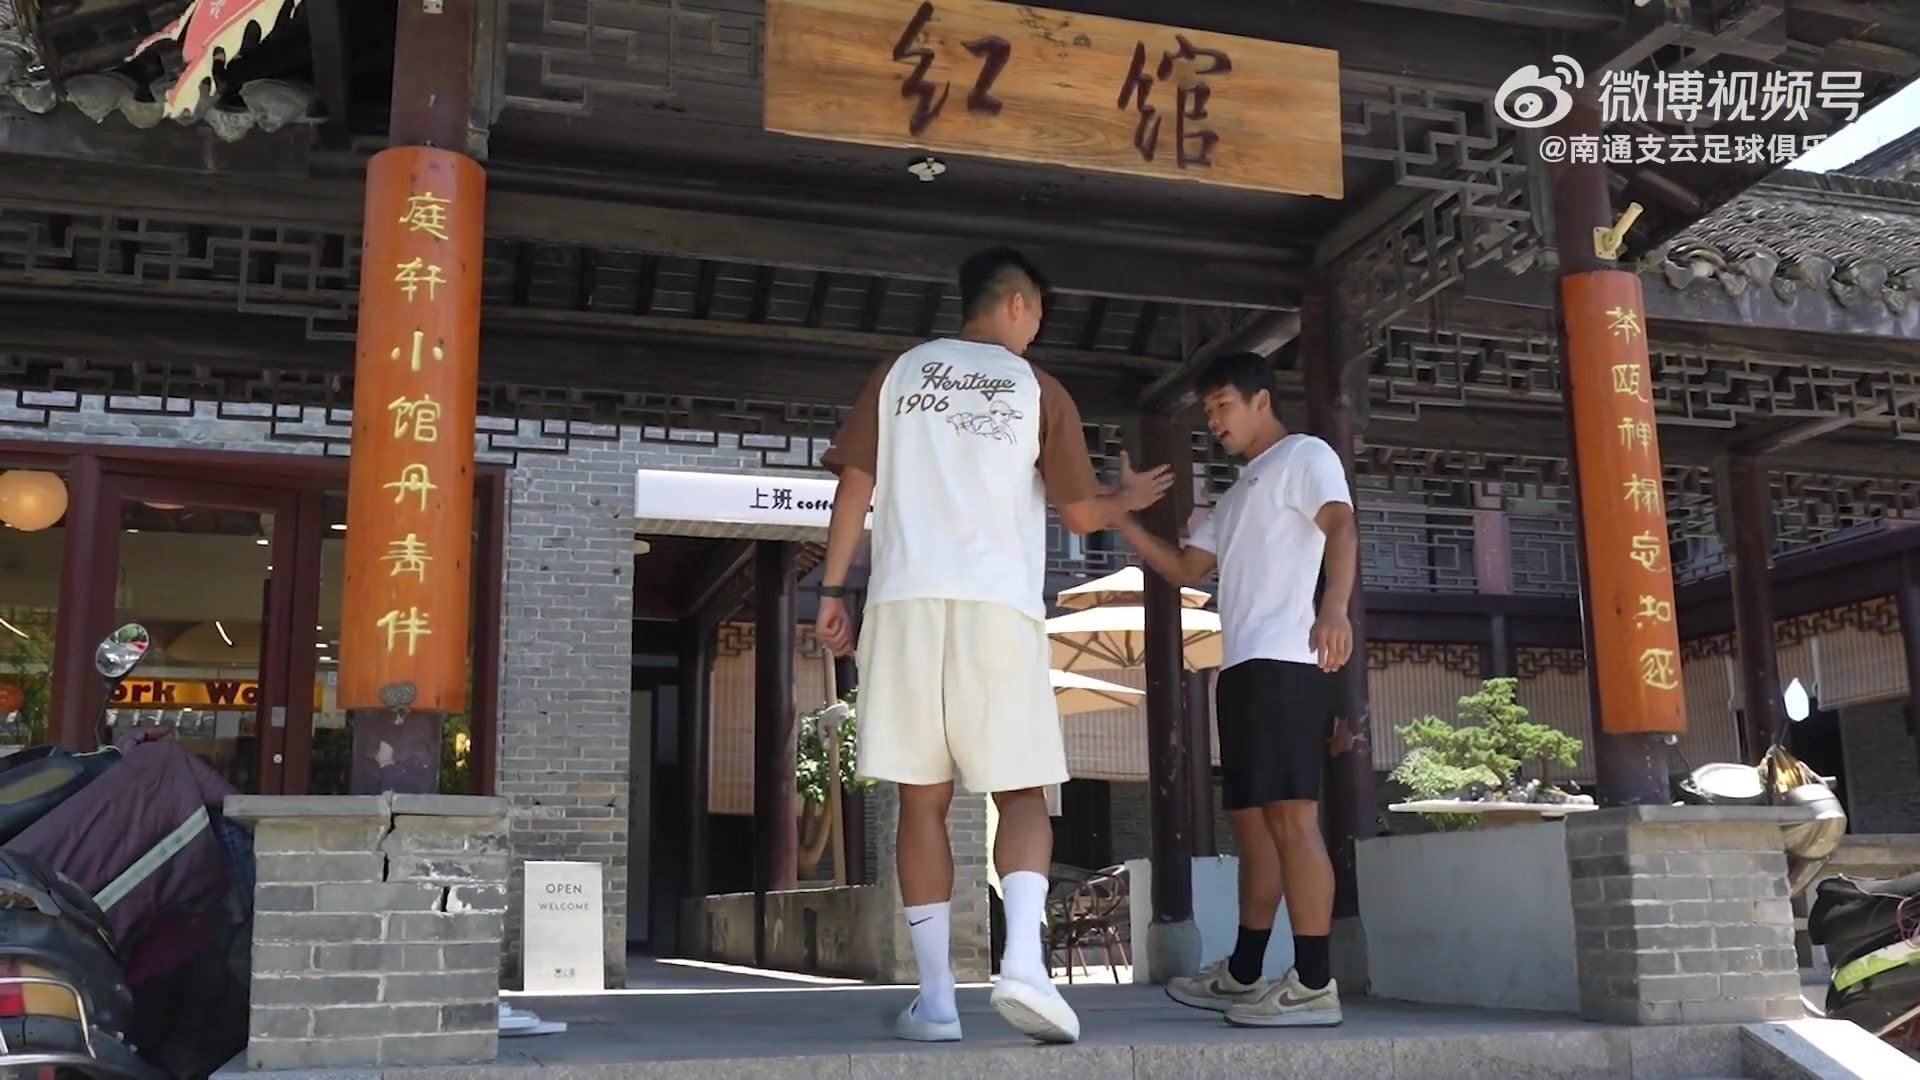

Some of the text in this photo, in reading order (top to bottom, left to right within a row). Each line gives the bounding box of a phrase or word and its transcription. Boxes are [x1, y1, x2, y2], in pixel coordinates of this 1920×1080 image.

[921, 361, 1016, 402] Heritage
[895, 393, 949, 416] 1906
[377, 192, 452, 657] 庭轩小馆丹青伴
[750, 486, 792, 510] 上班
[545, 883, 582, 894] OPEN
[538, 902, 590, 911] WELCOME
